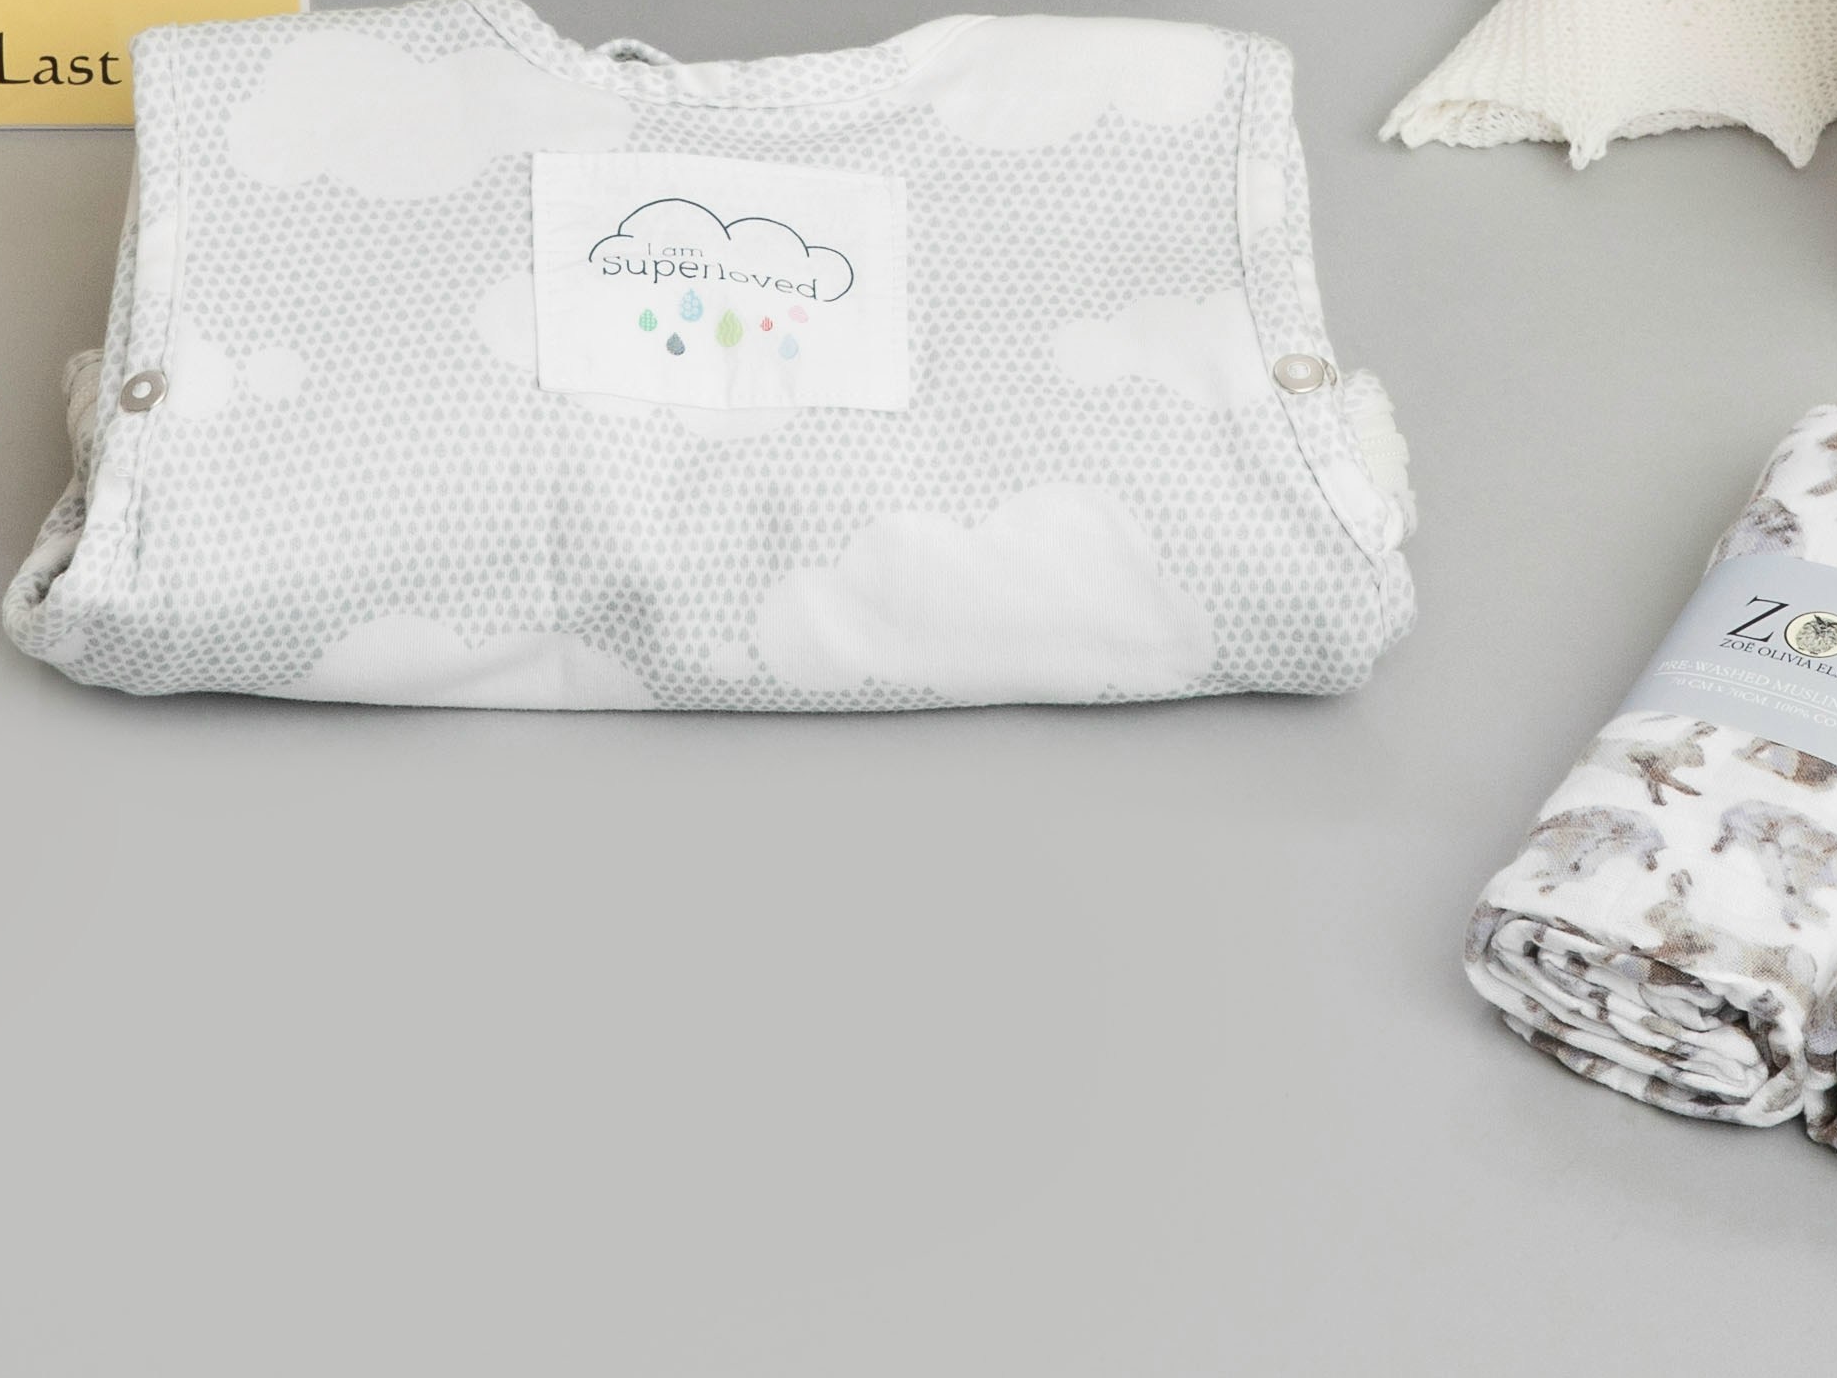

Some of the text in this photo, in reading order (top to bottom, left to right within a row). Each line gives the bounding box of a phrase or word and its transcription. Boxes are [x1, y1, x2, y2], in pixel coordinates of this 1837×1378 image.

[662, 246, 703, 257] am
[1720, 638, 1754, 653] ZOË
[1758, 645, 1812, 669] OLIVIA
